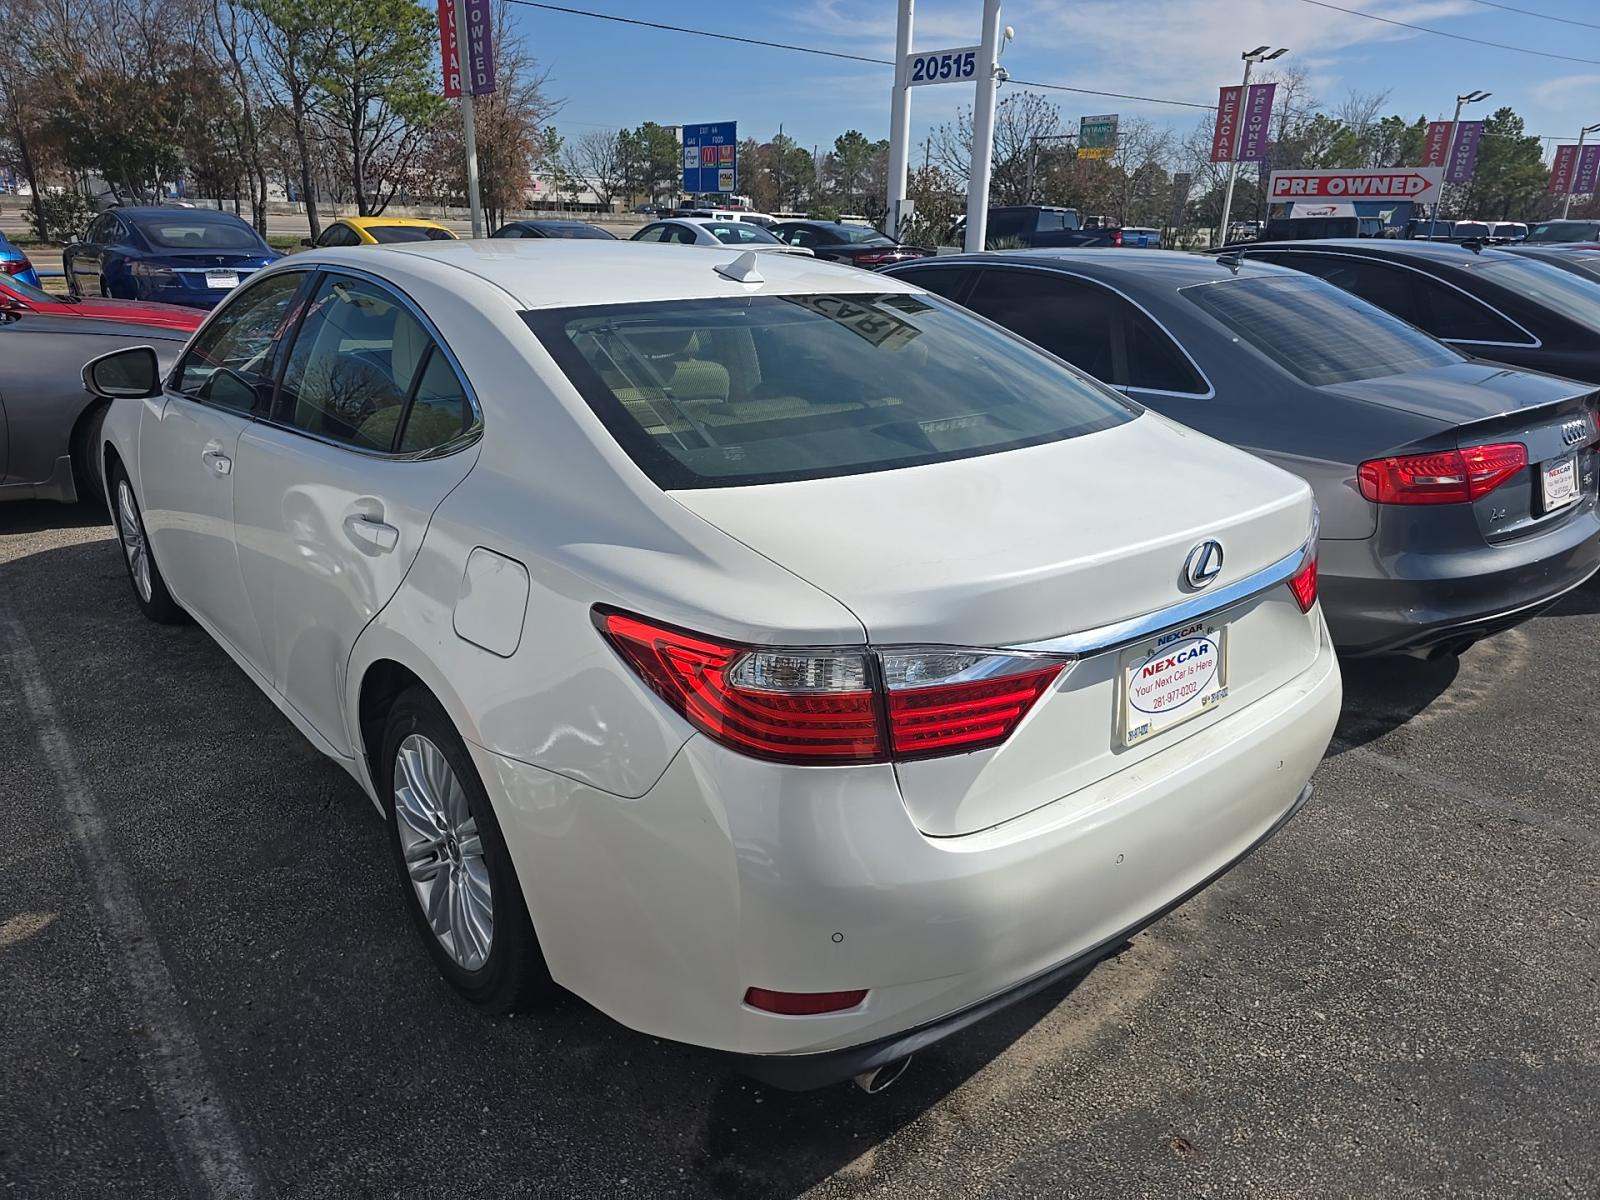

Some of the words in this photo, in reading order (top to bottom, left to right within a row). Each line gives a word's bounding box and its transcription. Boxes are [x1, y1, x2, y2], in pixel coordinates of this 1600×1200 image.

[912, 52, 976, 82] 20515
[1217, 91, 1237, 158] NEXCAR
[687, 137, 696, 145] GAS
[712, 135, 724, 144] FOOD
[1555, 147, 1572, 191] NEXCAR
[1274, 178, 1319, 195] PRE
[1326, 176, 1425, 195] OWNED
[1157, 623, 1203, 646] NEXCAR
[1142, 643, 1208, 679] NEXCAR
[1135, 683, 1153, 698] Your
[1155, 675, 1172, 689] Next
[1173, 670, 1186, 682] Car
[1187, 666, 1194, 676] Is
[1195, 659, 1213, 672] Here
[1152, 681, 1197, 710] 281-977-0202
